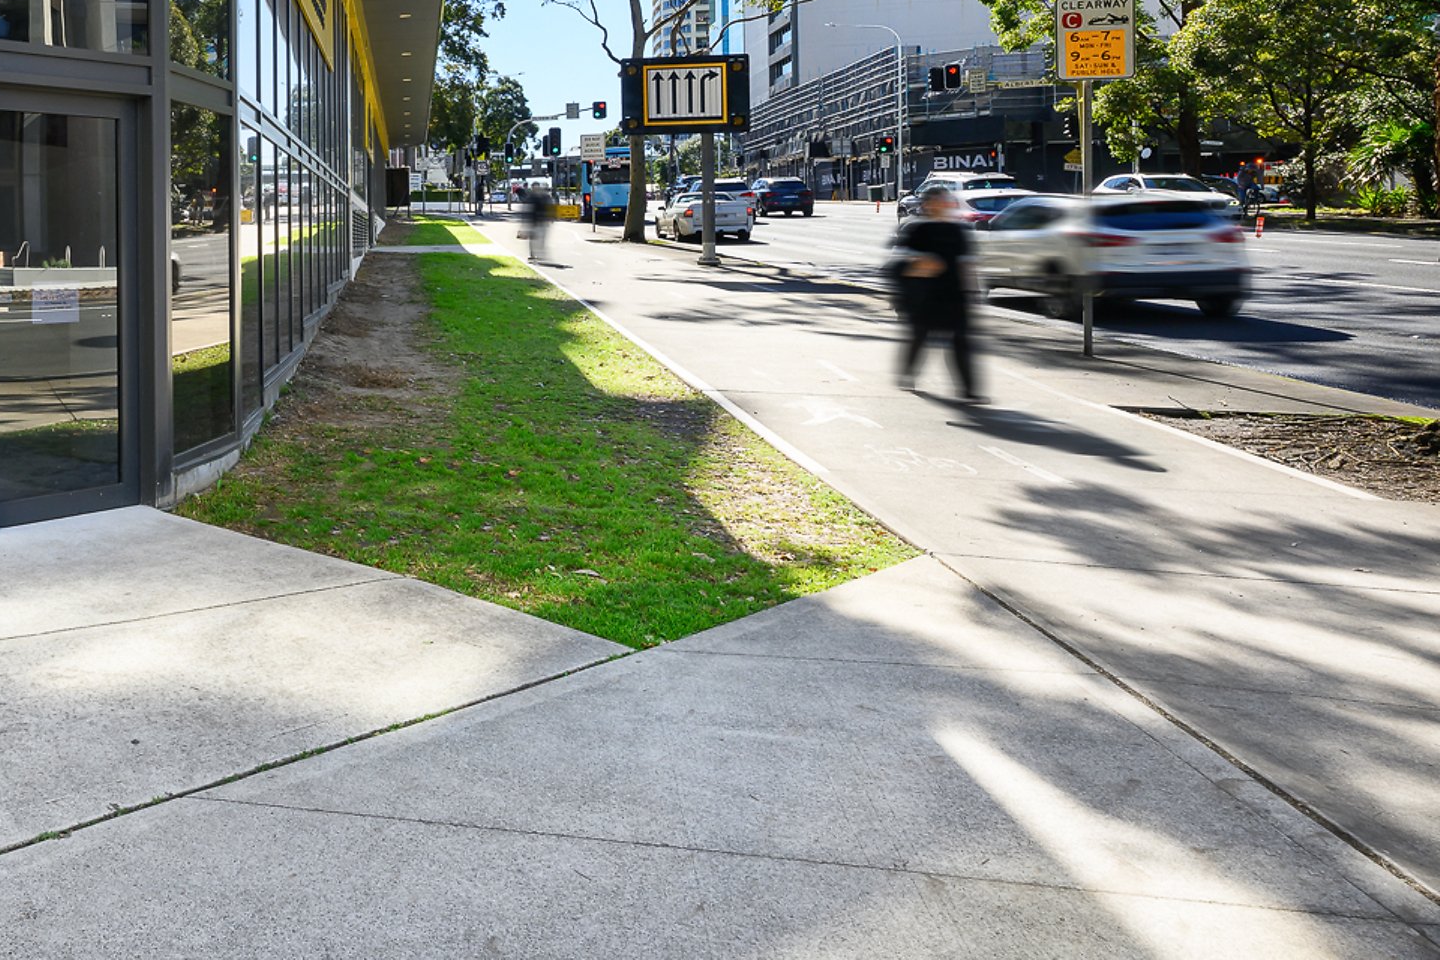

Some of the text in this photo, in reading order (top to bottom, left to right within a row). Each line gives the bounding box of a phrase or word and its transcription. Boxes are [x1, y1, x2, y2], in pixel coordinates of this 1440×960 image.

[1061, 0, 1129, 10] CLEARWAY
[1066, 14, 1078, 27] C
[933, 154, 1006, 170] BINAH
